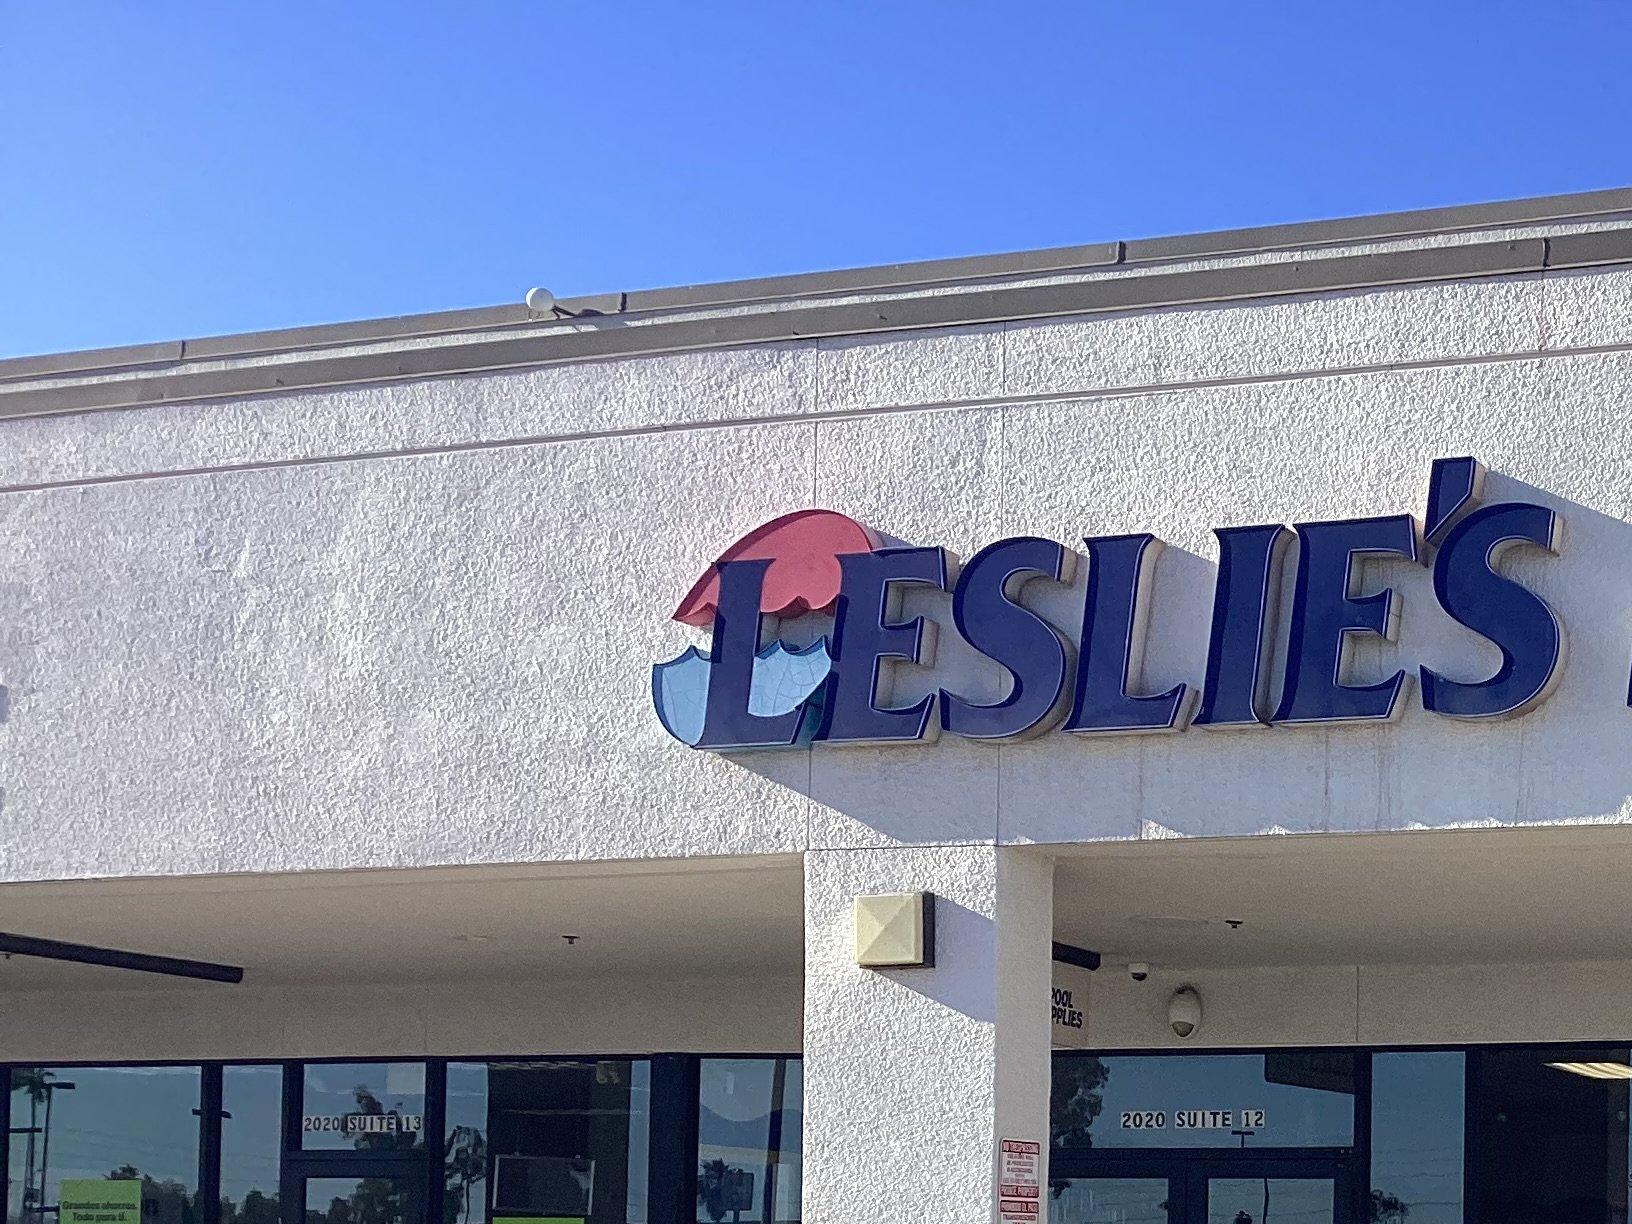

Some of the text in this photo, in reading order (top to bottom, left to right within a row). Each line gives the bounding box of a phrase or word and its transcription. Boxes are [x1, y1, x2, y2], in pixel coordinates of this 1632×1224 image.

[694, 456, 1570, 750] LESLIE'S
[1051, 1005, 1083, 1029] PPLIES
[304, 1116, 422, 1132] 2020 SUITE 13
[1121, 1111, 1264, 1129] 2020 SUITE 12
